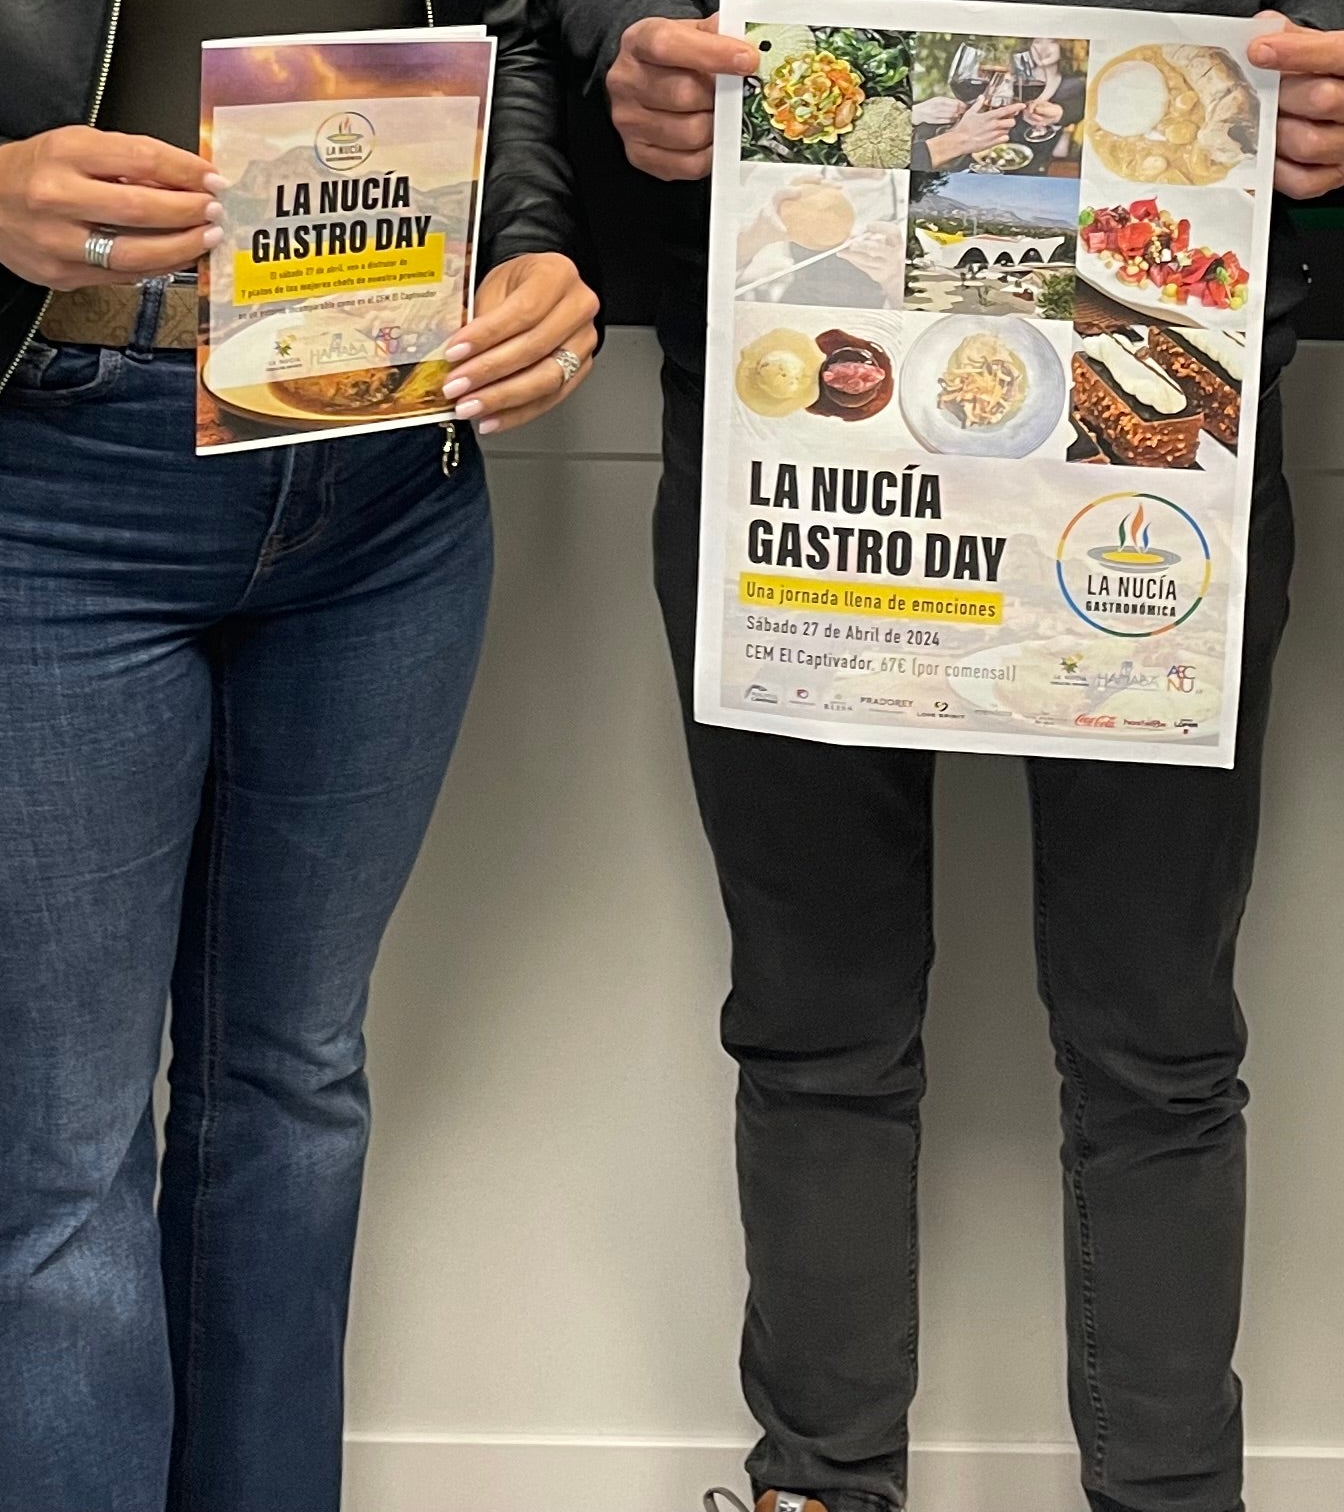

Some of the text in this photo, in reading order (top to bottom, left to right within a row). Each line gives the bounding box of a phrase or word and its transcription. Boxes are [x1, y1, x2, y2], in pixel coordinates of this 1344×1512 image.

[326, 145, 336, 155] LA
[276, 170, 410, 217] LA NUCÍA
[252, 215, 432, 263] GASTRO DAY
[750, 460, 942, 519] LA NUCÍA
[747, 519, 1007, 582] GASTRO DAY
[747, 582, 996, 617] Una jornada llena de emociones
[1086, 575, 1177, 600] LA NUCÍA
[1085, 600, 1176, 617] GASTRONÓMICA
[747, 615, 940, 646] Sábado 27 de Abril de 2024
[745, 644, 773, 661] CEM
[780, 647, 792, 663] El
[881, 657, 905, 673] 67€
[912, 660, 939, 677] (por
[945, 664, 1016, 681] comensal)
